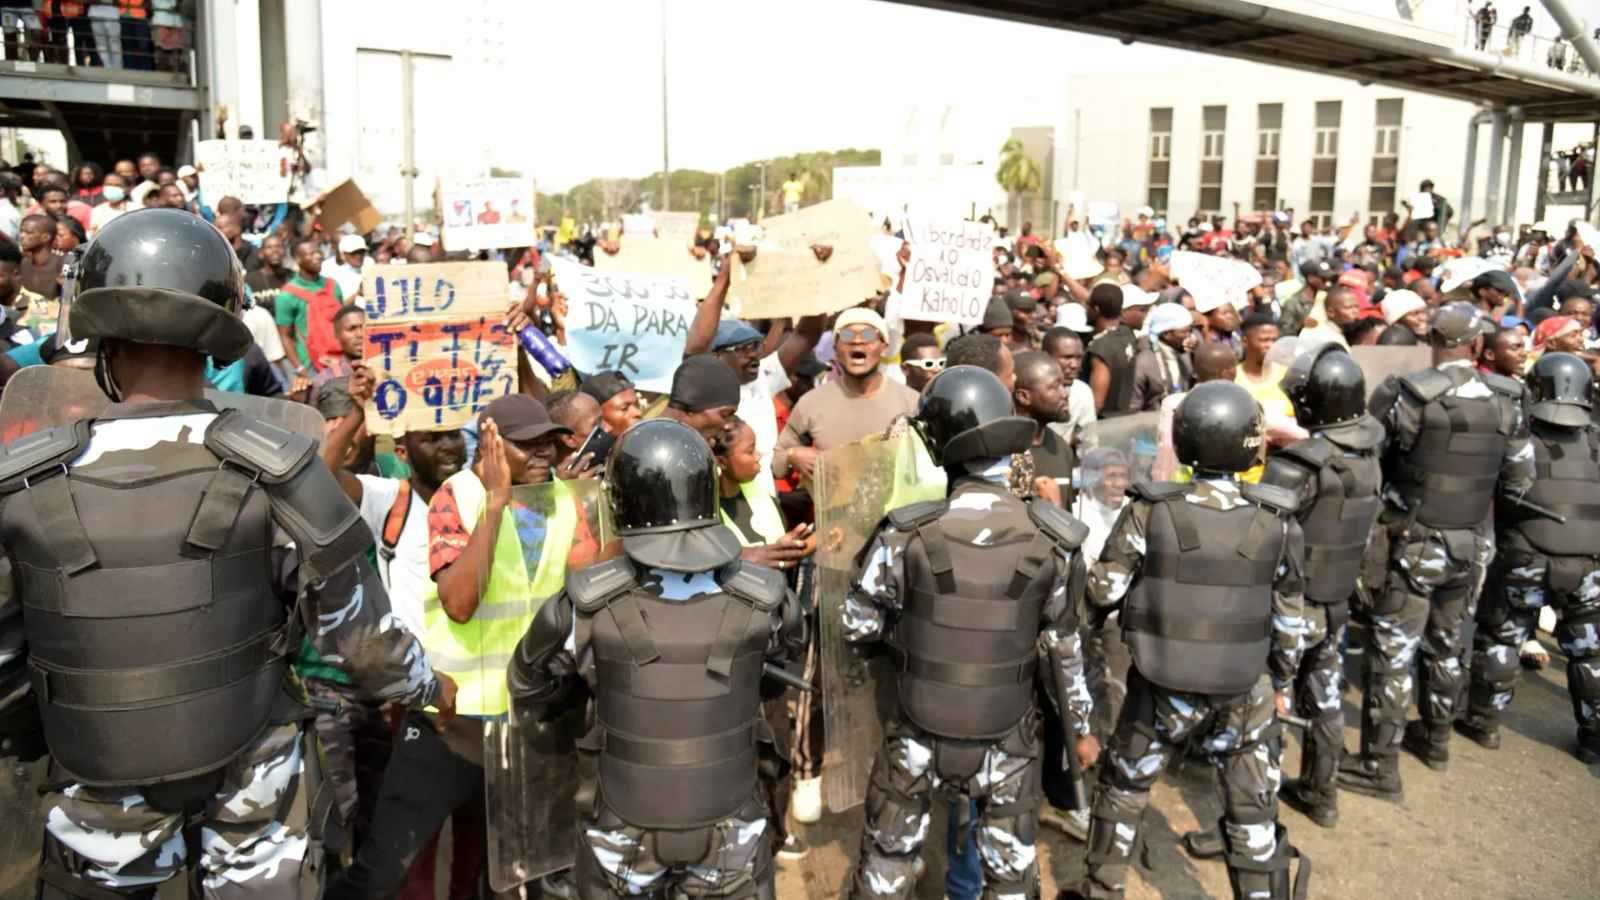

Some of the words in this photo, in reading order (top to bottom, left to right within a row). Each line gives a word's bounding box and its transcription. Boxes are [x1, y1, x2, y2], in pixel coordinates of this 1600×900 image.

[632, 304, 689, 336] PARA
[596, 342, 639, 374] IR
[374, 378, 408, 419] O
